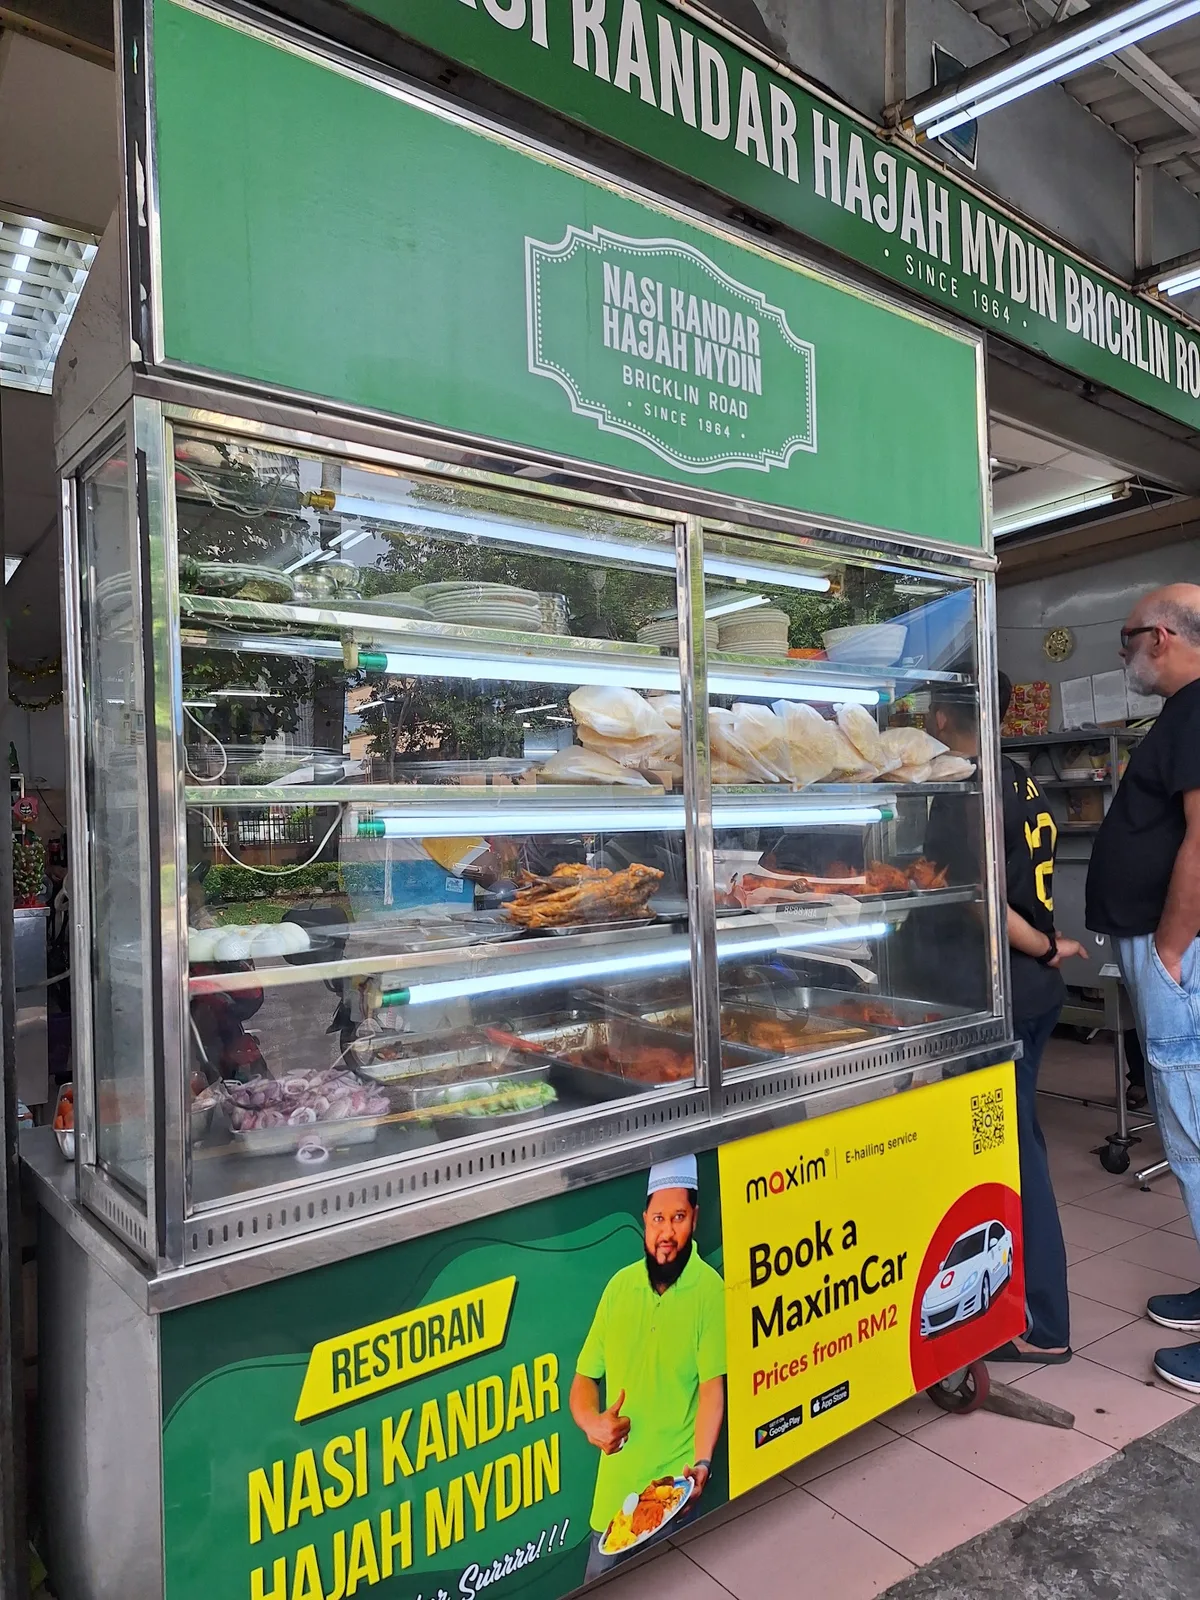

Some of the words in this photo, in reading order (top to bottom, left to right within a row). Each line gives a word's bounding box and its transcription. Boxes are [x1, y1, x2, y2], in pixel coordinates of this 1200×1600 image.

[572, 0, 800, 185] KANDAR
[811, 108, 952, 266] HAJAH
[960, 199, 1058, 323] MYDIN
[1063, 263, 1171, 384] BRICKLIN
[1174, 331, 1200, 399] RO
[602, 260, 664, 324] NASI
[670, 286, 761, 357] KANDAR
[905, 253, 959, 299] SINCE
[972, 289, 1011, 324] 1964
[602, 304, 688, 373] HAJAH
[693, 336, 763, 396] MYDIN
[622, 364, 700, 406] BRICKLIN
[708, 391, 748, 420] ROAD
[643, 402, 688, 427] SINCE
[698, 417, 731, 438] 1964
[745, 1154, 827, 1204] maxim
[845, 1141, 885, 1164] E-hailing
[887, 1130, 918, 1150] service
[749, 1219, 834, 1290] Book
[841, 1218, 858, 1250] a
[751, 1251, 908, 1349] MaximCar
[331, 1298, 485, 1395] RESTORAN
[752, 1353, 808, 1397] Prices
[812, 1331, 853, 1367] from
[857, 1303, 898, 1345] RM2
[247, 1426, 369, 1545] NASI
[381, 1351, 561, 1487] KANDAR
[424, 1431, 561, 1557] MYDIN
